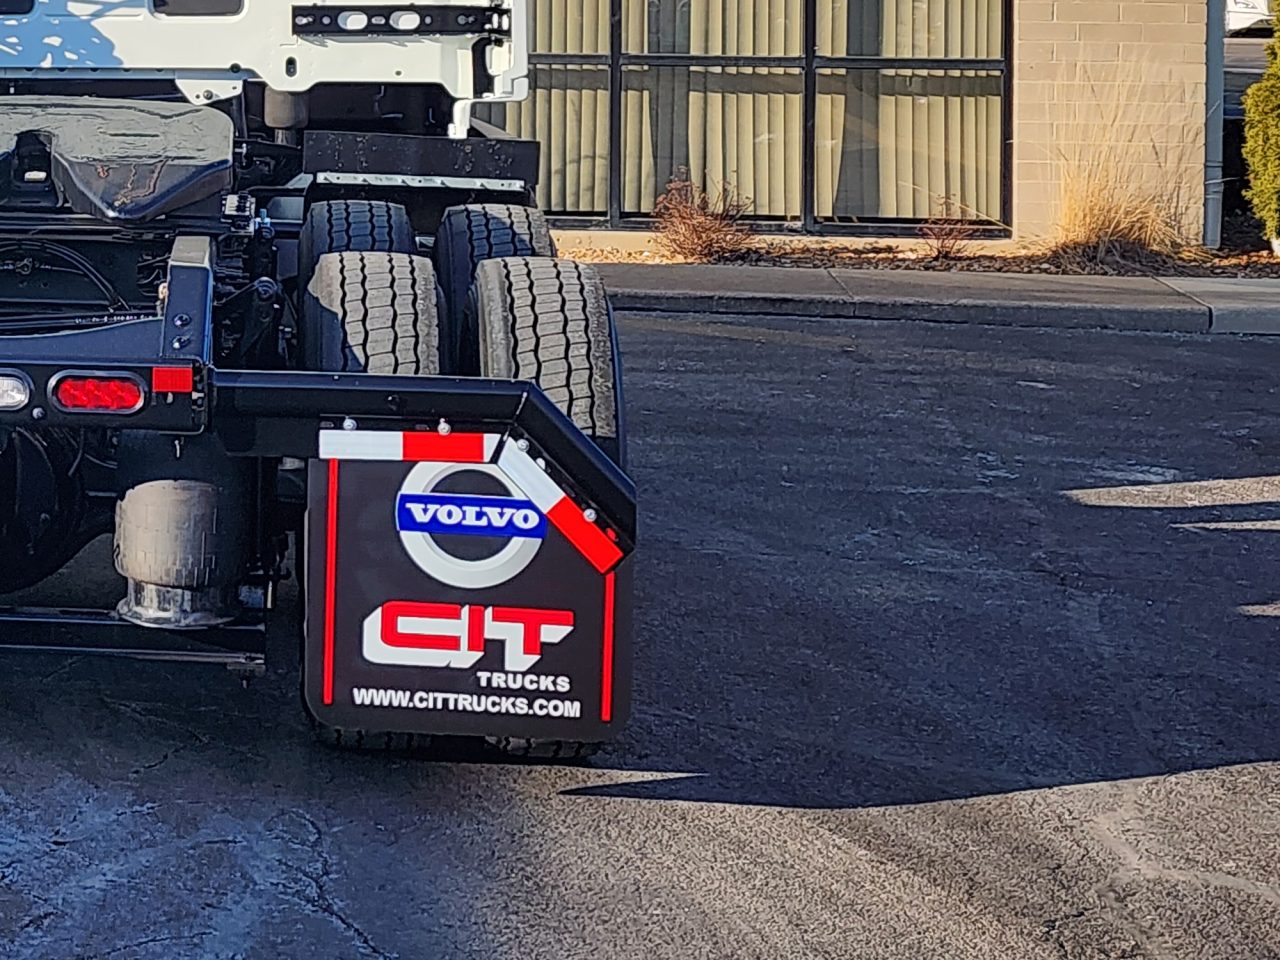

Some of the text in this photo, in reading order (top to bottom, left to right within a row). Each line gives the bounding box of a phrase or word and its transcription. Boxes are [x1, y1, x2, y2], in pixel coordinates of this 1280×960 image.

[405, 502, 540, 530] VOLVO
[363, 600, 575, 672] CIT
[476, 671, 571, 693] TRUCKS
[352, 687, 581, 719] WWW.CITTRUCKS.COM
